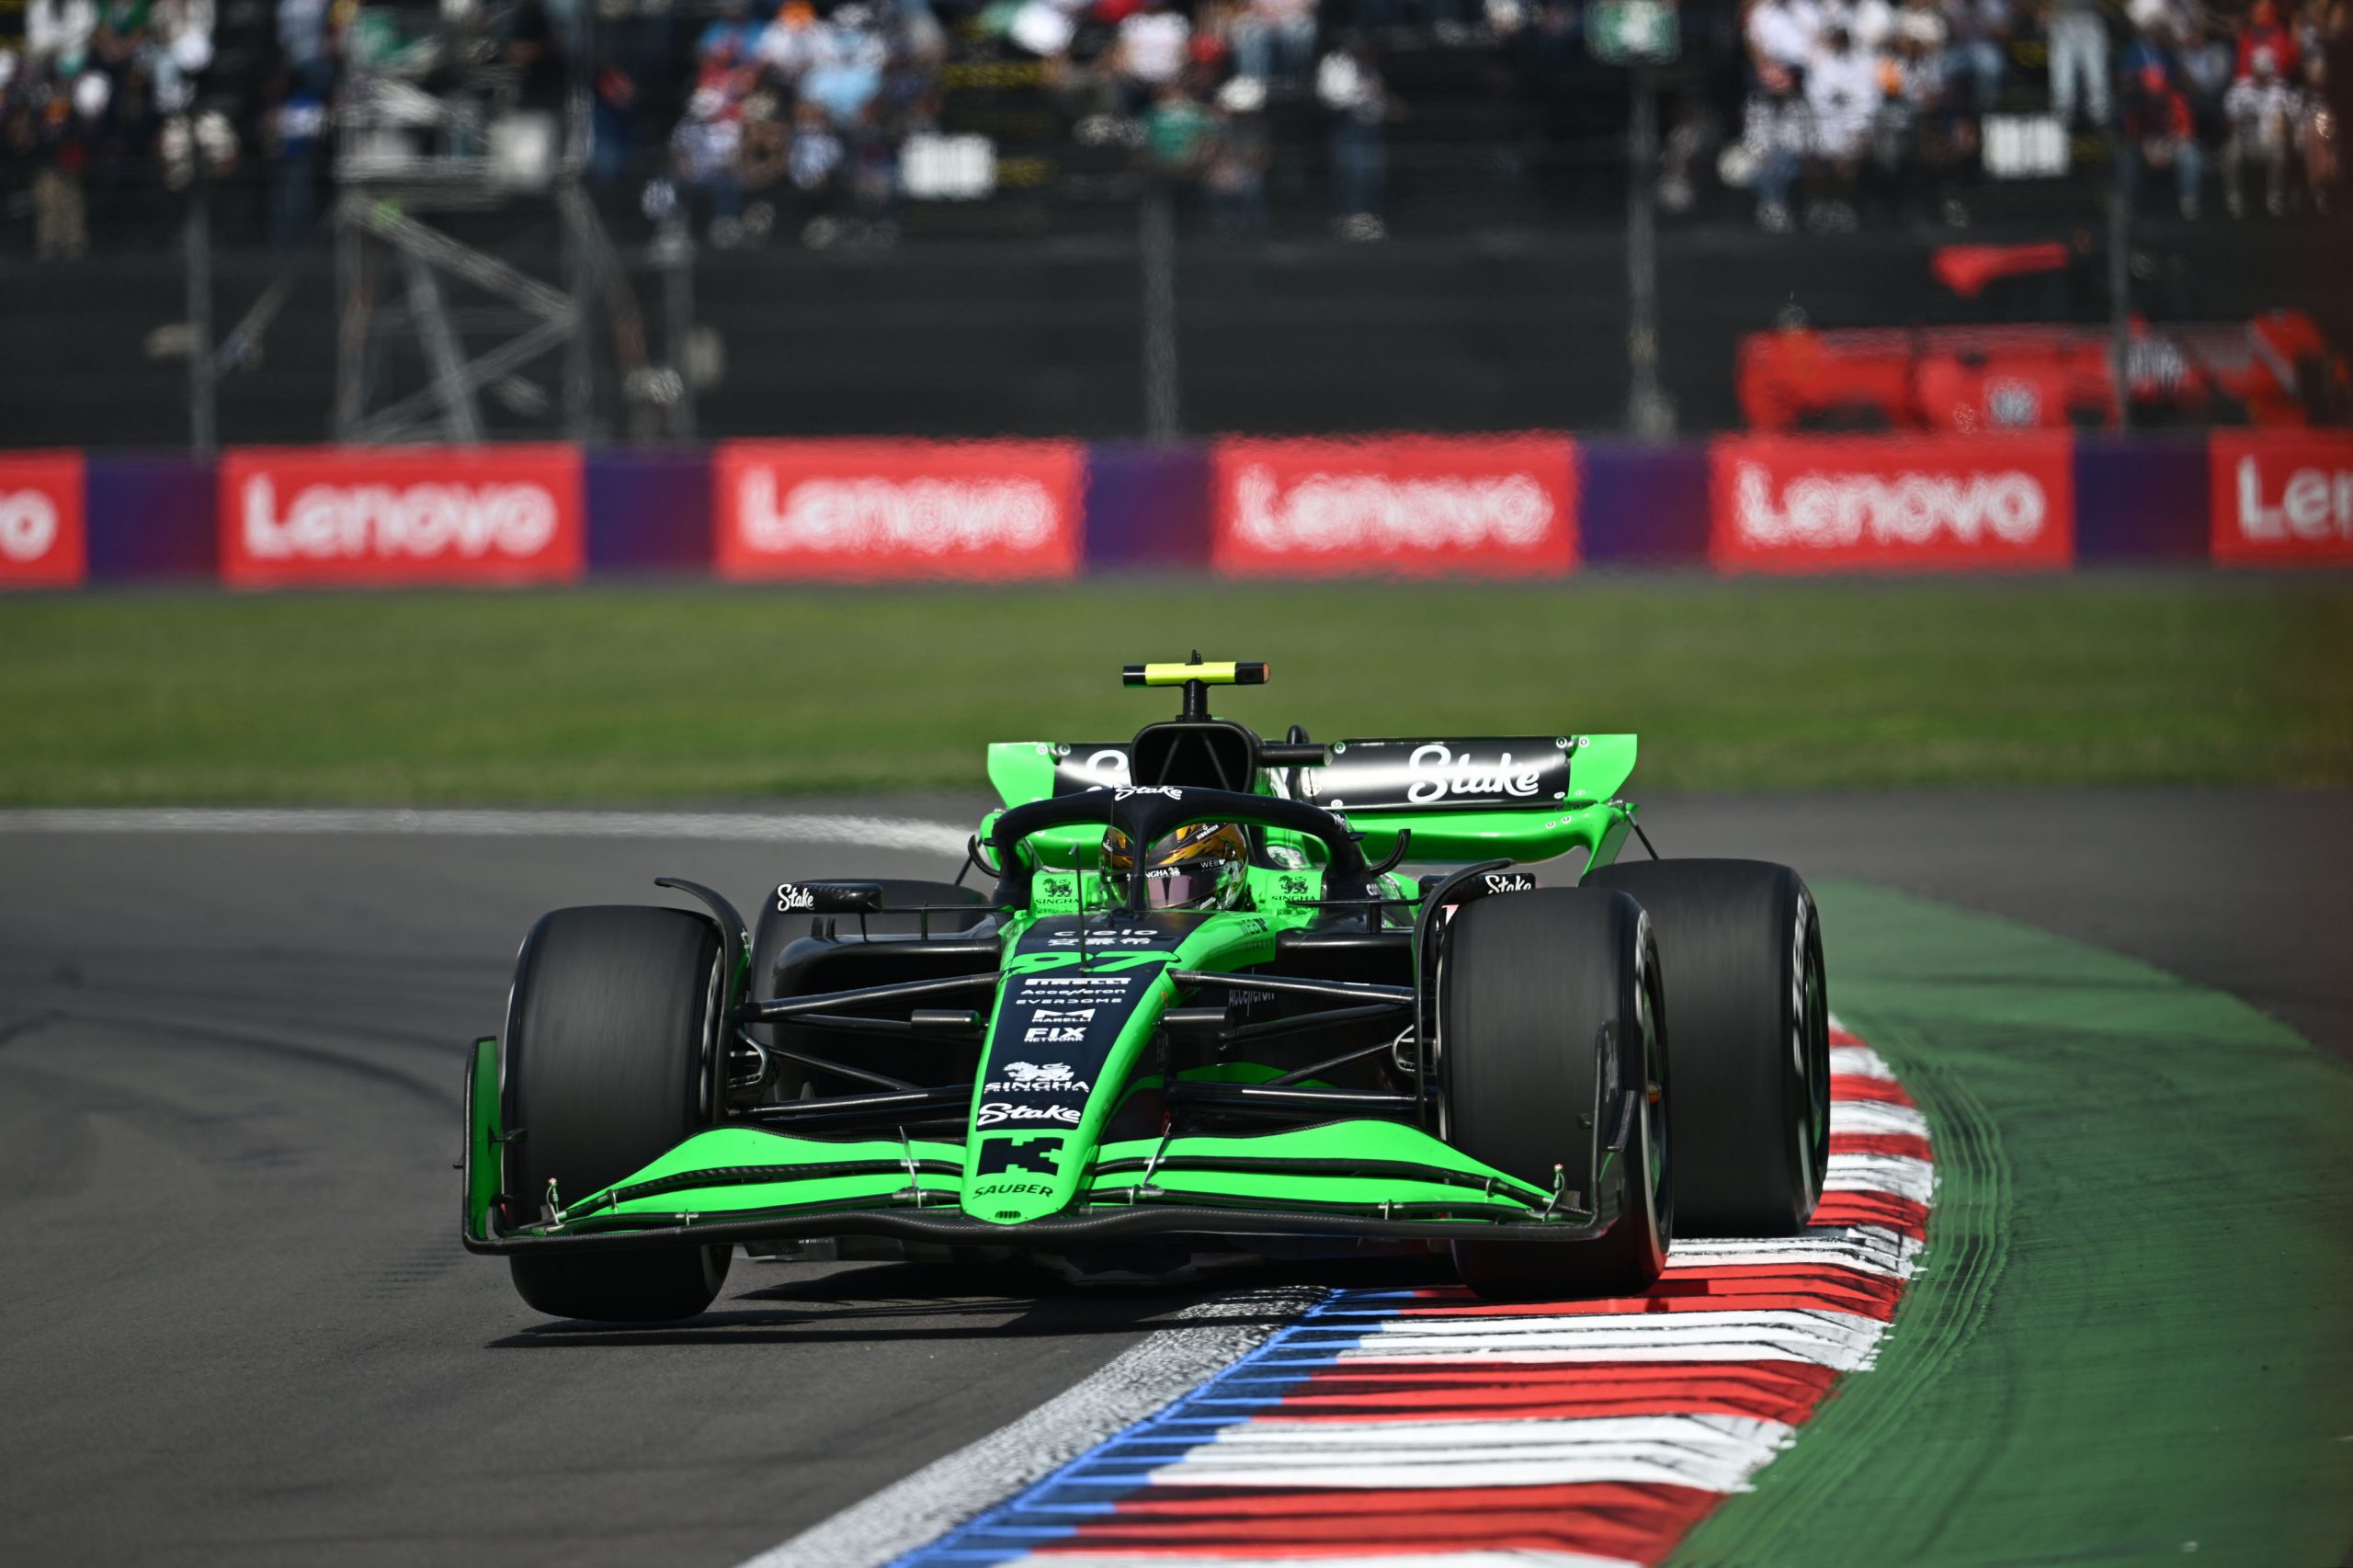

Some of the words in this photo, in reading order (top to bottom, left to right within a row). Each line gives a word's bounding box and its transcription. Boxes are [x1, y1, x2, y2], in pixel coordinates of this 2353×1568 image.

[244, 472, 557, 557] Lenovo
[739, 463, 1057, 553] Lenovo
[1233, 461, 1553, 551] Lenovo
[1733, 458, 2044, 546] Lenovo
[1408, 744, 1540, 803] Stake
[1114, 786, 1183, 801] Stake
[777, 883, 815, 913] Stake
[1024, 977, 1131, 986] PIRELLI
[1027, 1027, 1086, 1038] FIX
[984, 1081, 1089, 1092] SINGHA
[976, 1103, 1081, 1126] Stake
[972, 1184, 1053, 1199] SAUBER
